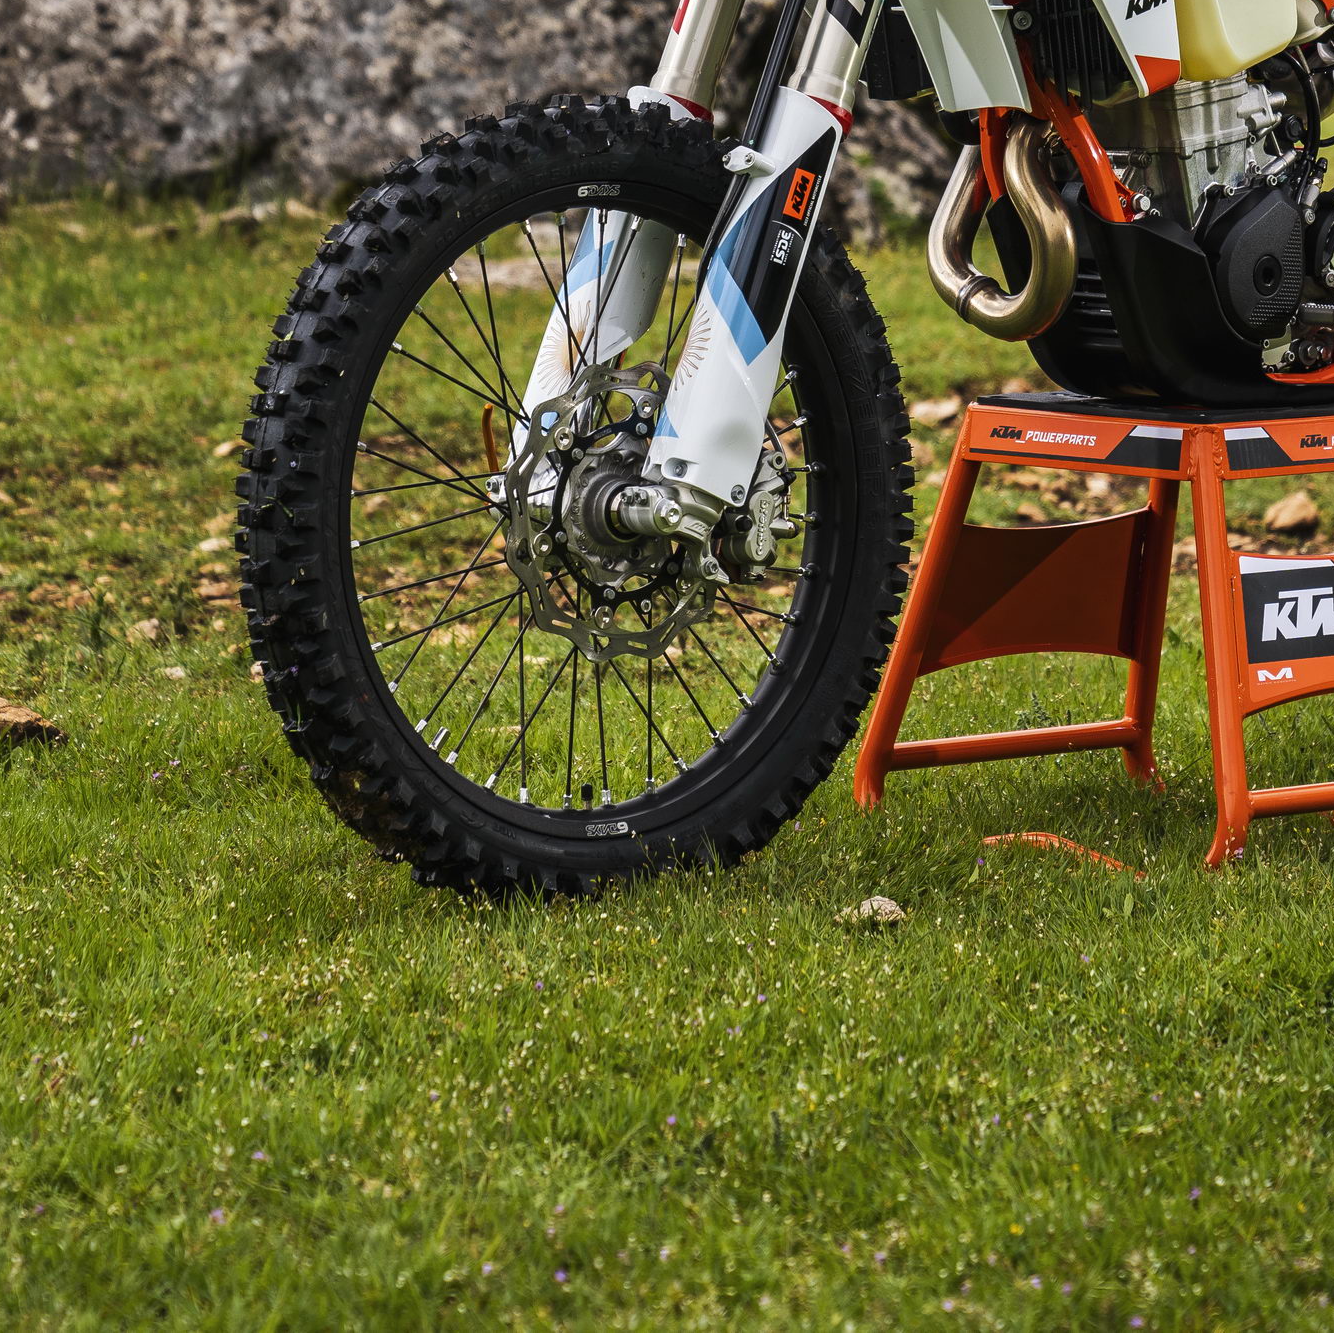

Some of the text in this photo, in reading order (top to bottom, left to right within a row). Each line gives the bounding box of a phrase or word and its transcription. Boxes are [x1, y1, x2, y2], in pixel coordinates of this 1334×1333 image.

[577, 184, 621, 197] 6DAYS
[791, 175, 810, 214] KTM
[773, 230, 792, 264] ISDE
